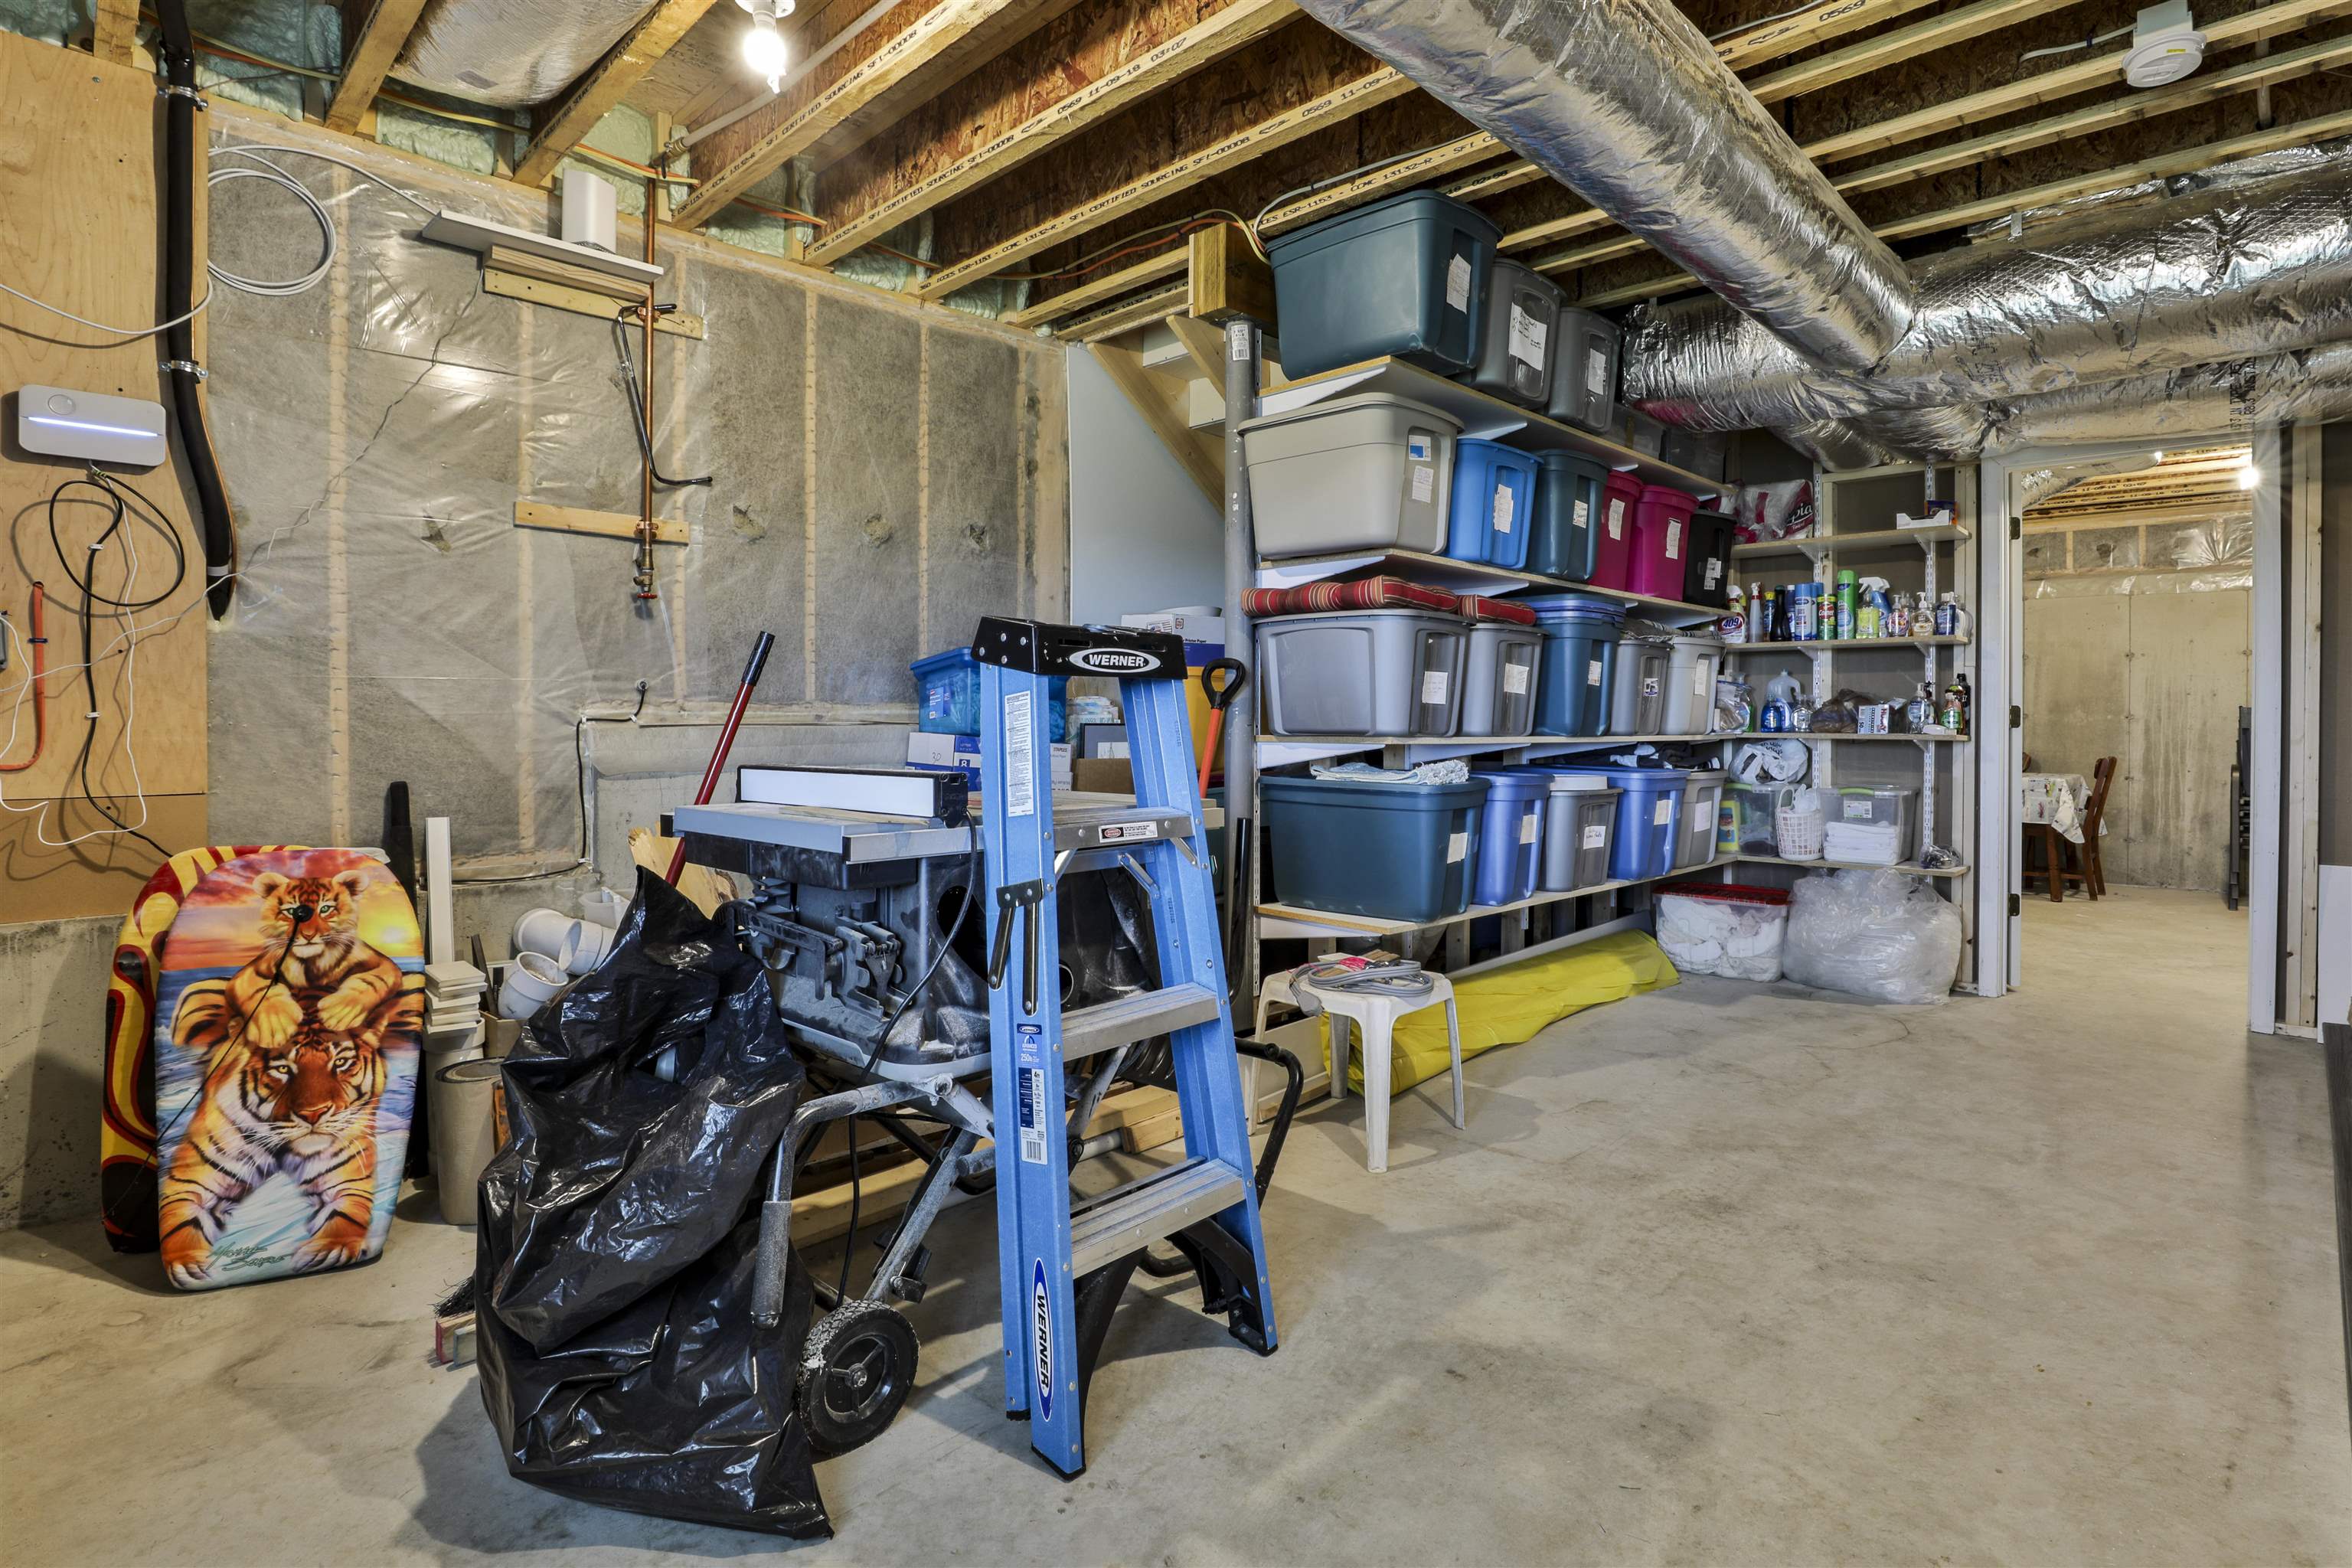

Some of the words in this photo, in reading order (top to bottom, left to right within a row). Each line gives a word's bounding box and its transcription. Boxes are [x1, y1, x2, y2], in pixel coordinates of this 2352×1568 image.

[782, 102, 822, 136] CERTIFIED
[824, 69, 864, 103] SOURCING
[884, 187, 923, 213] CERTIFIED
[926, 164, 965, 188] SOURCING
[968, 134, 1014, 165] SFI-00008
[1057, 96, 1083, 115] 0569
[1087, 64, 1141, 99] 11-09-18
[1150, 37, 1187, 63] 03:07
[1001, 241, 1021, 253] CCMC
[1069, 211, 1084, 222] SFI
[1089, 187, 1137, 213] CERTIFIED
[1141, 164, 1188, 189] SOURCING
[1193, 136, 1250, 165] SFI-00008
[1302, 100, 1332, 117] 0569
[1283, 194, 1332, 218] ESR-1153
[1351, 178, 1377, 192] CCMC
[1383, 157, 1433, 179] 13132-R
[1453, 141, 1476, 154] SFI
[1088, 654, 1145, 668] WERNER
[1723, 617, 1740, 628] 409
[1037, 1294, 1050, 1389] WERNER
